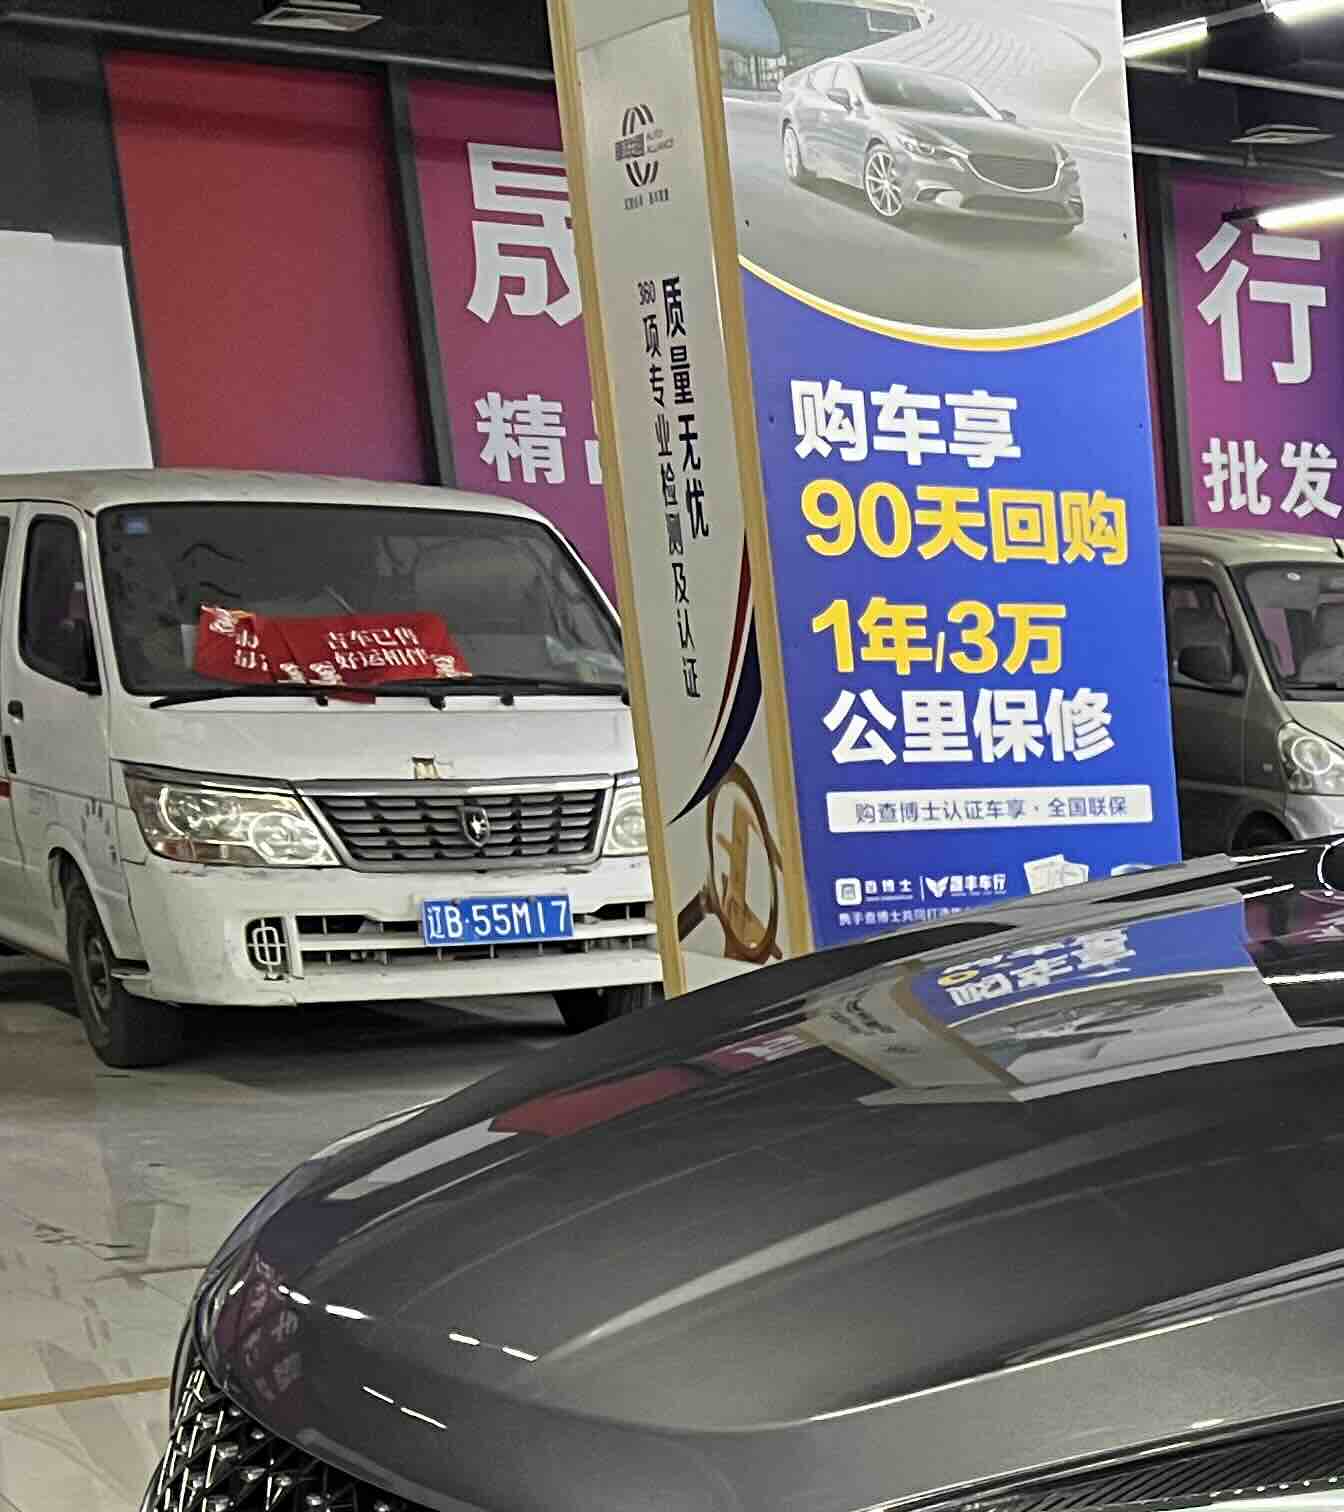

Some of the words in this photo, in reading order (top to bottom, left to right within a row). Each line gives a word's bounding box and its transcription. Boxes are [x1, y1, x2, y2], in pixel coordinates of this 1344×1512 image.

[1196, 222, 1327, 385] 行
[661, 275, 709, 539] 质量无忧
[789, 379, 1022, 468] 购车享
[1201, 437, 1343, 519] 批发
[801, 479, 1129, 566] 90天回购
[823, 686, 1115, 766] 公里保修
